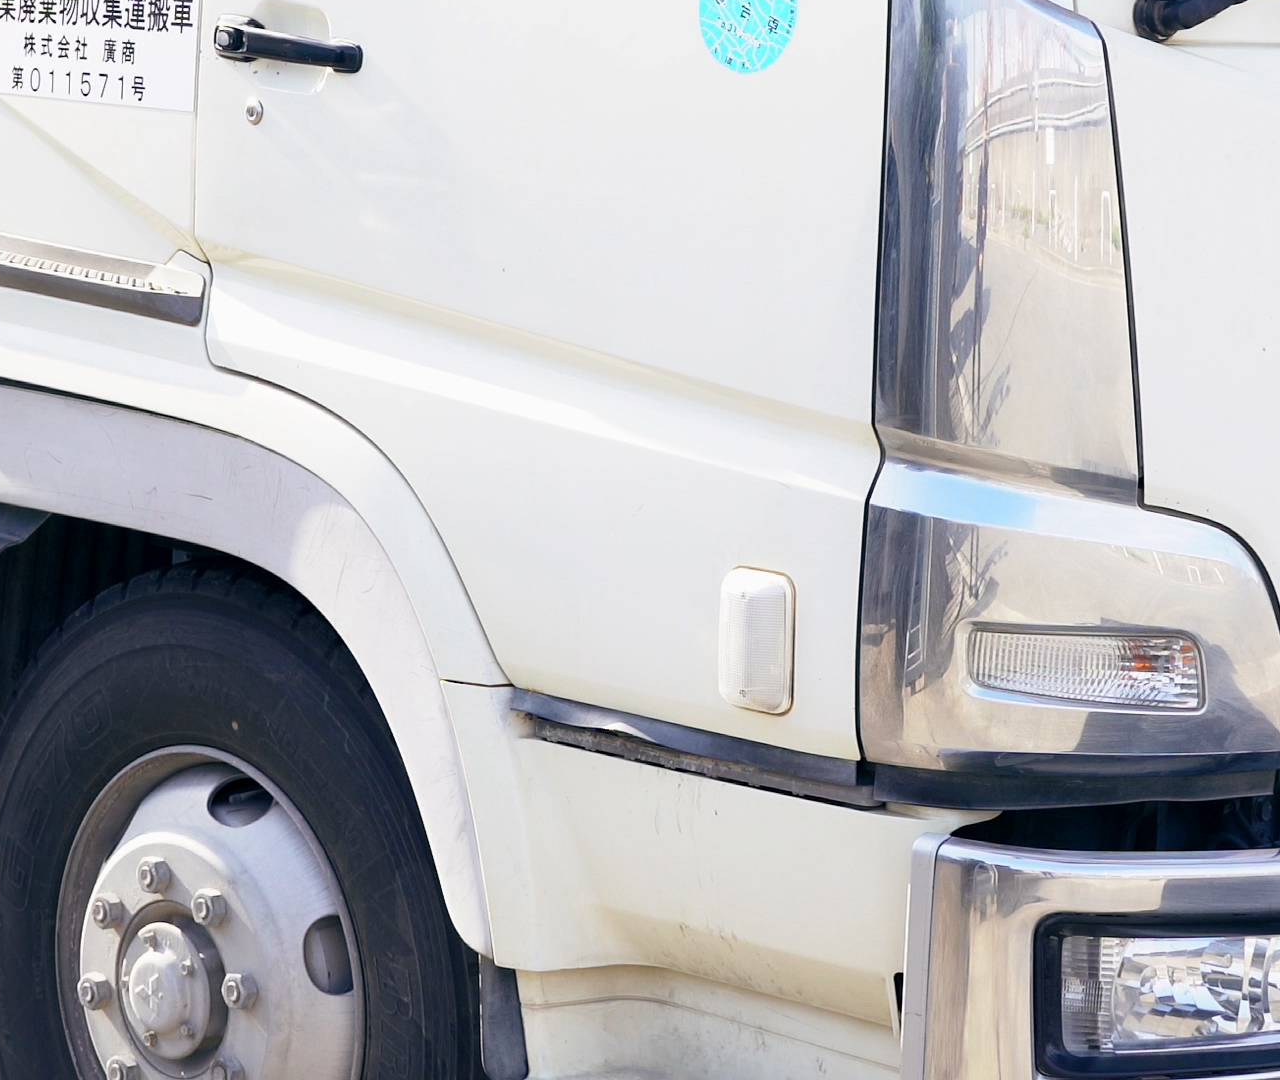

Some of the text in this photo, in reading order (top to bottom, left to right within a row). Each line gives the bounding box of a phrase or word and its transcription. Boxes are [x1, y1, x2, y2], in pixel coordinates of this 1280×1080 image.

[23, 32, 88, 61] 株式会社
[11, 66, 147, 102] 第011571号
